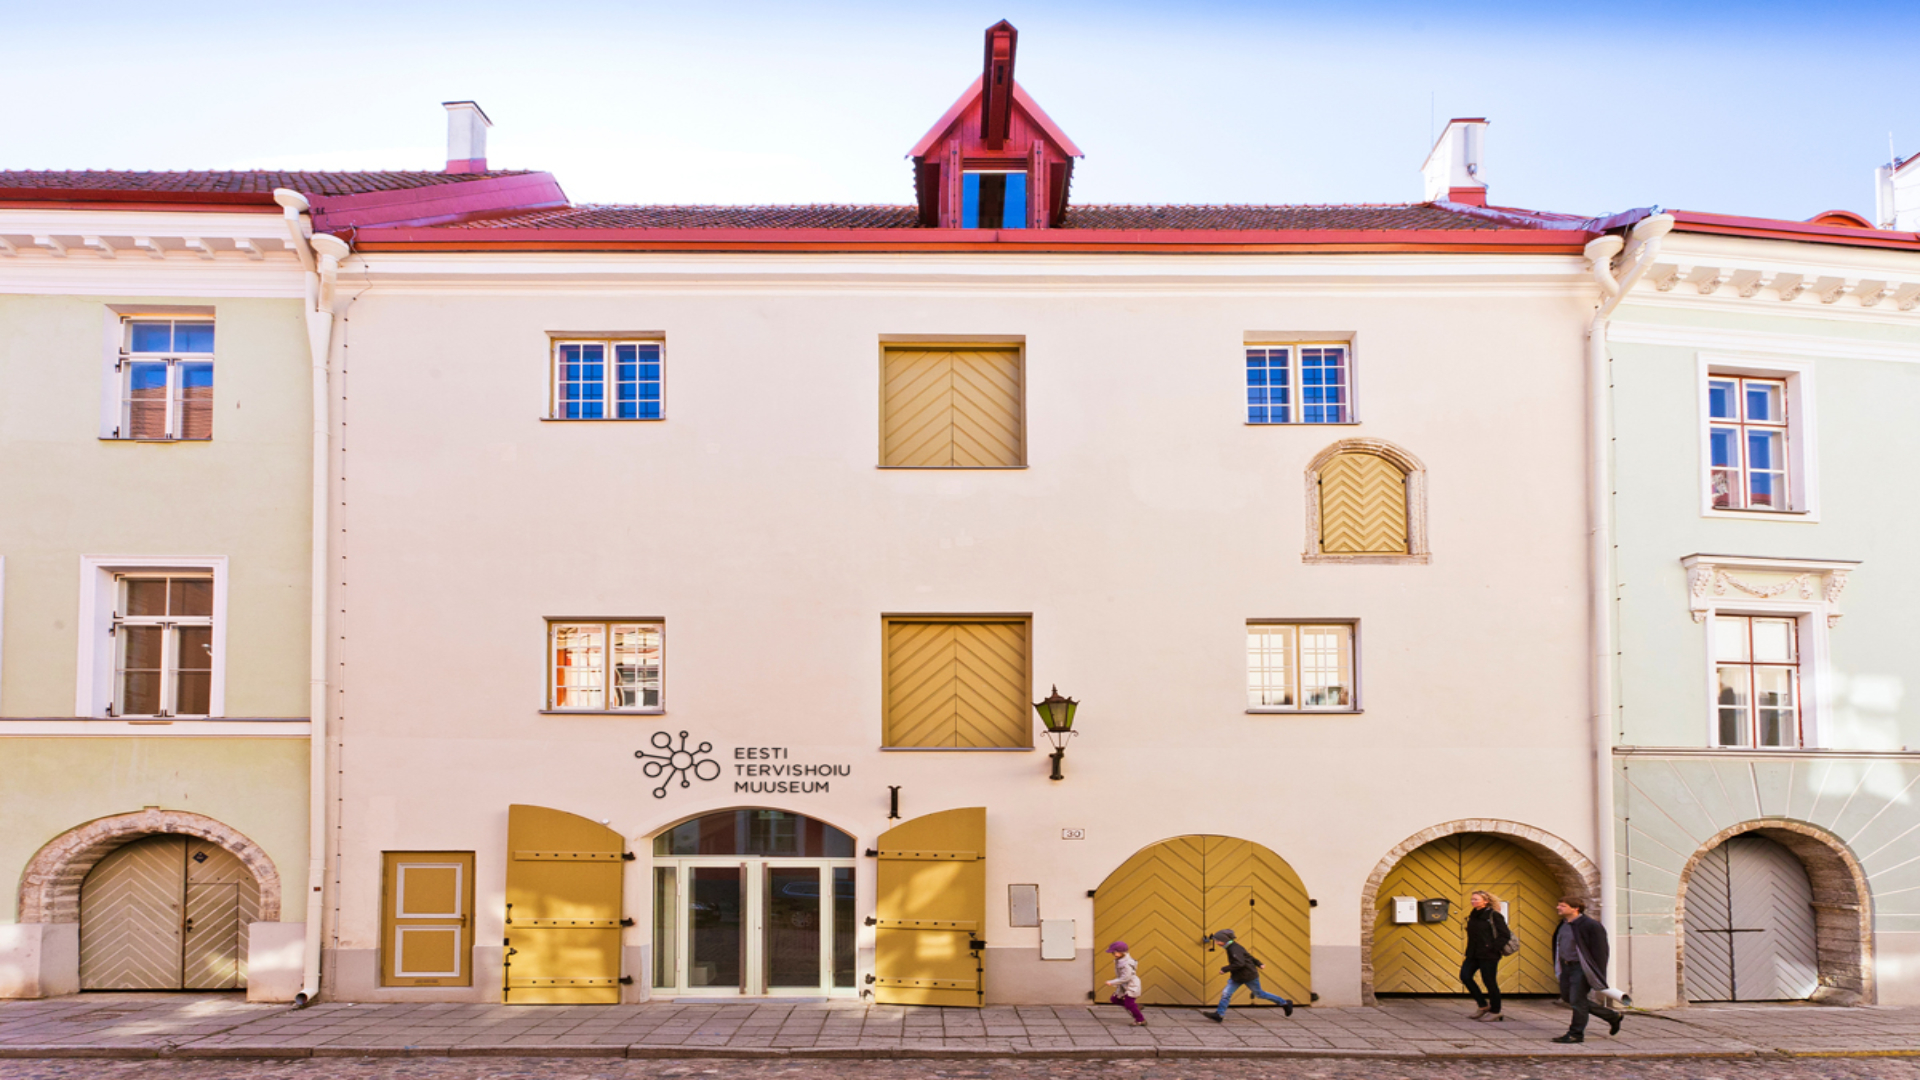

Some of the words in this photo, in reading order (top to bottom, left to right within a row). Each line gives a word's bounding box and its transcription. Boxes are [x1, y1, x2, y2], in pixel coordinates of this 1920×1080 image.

[734, 747, 788, 759] EESTI
[734, 764, 851, 776] TERVISHOIU
[734, 781, 829, 793] MUUSEUM
[1066, 829, 1081, 838] 30
